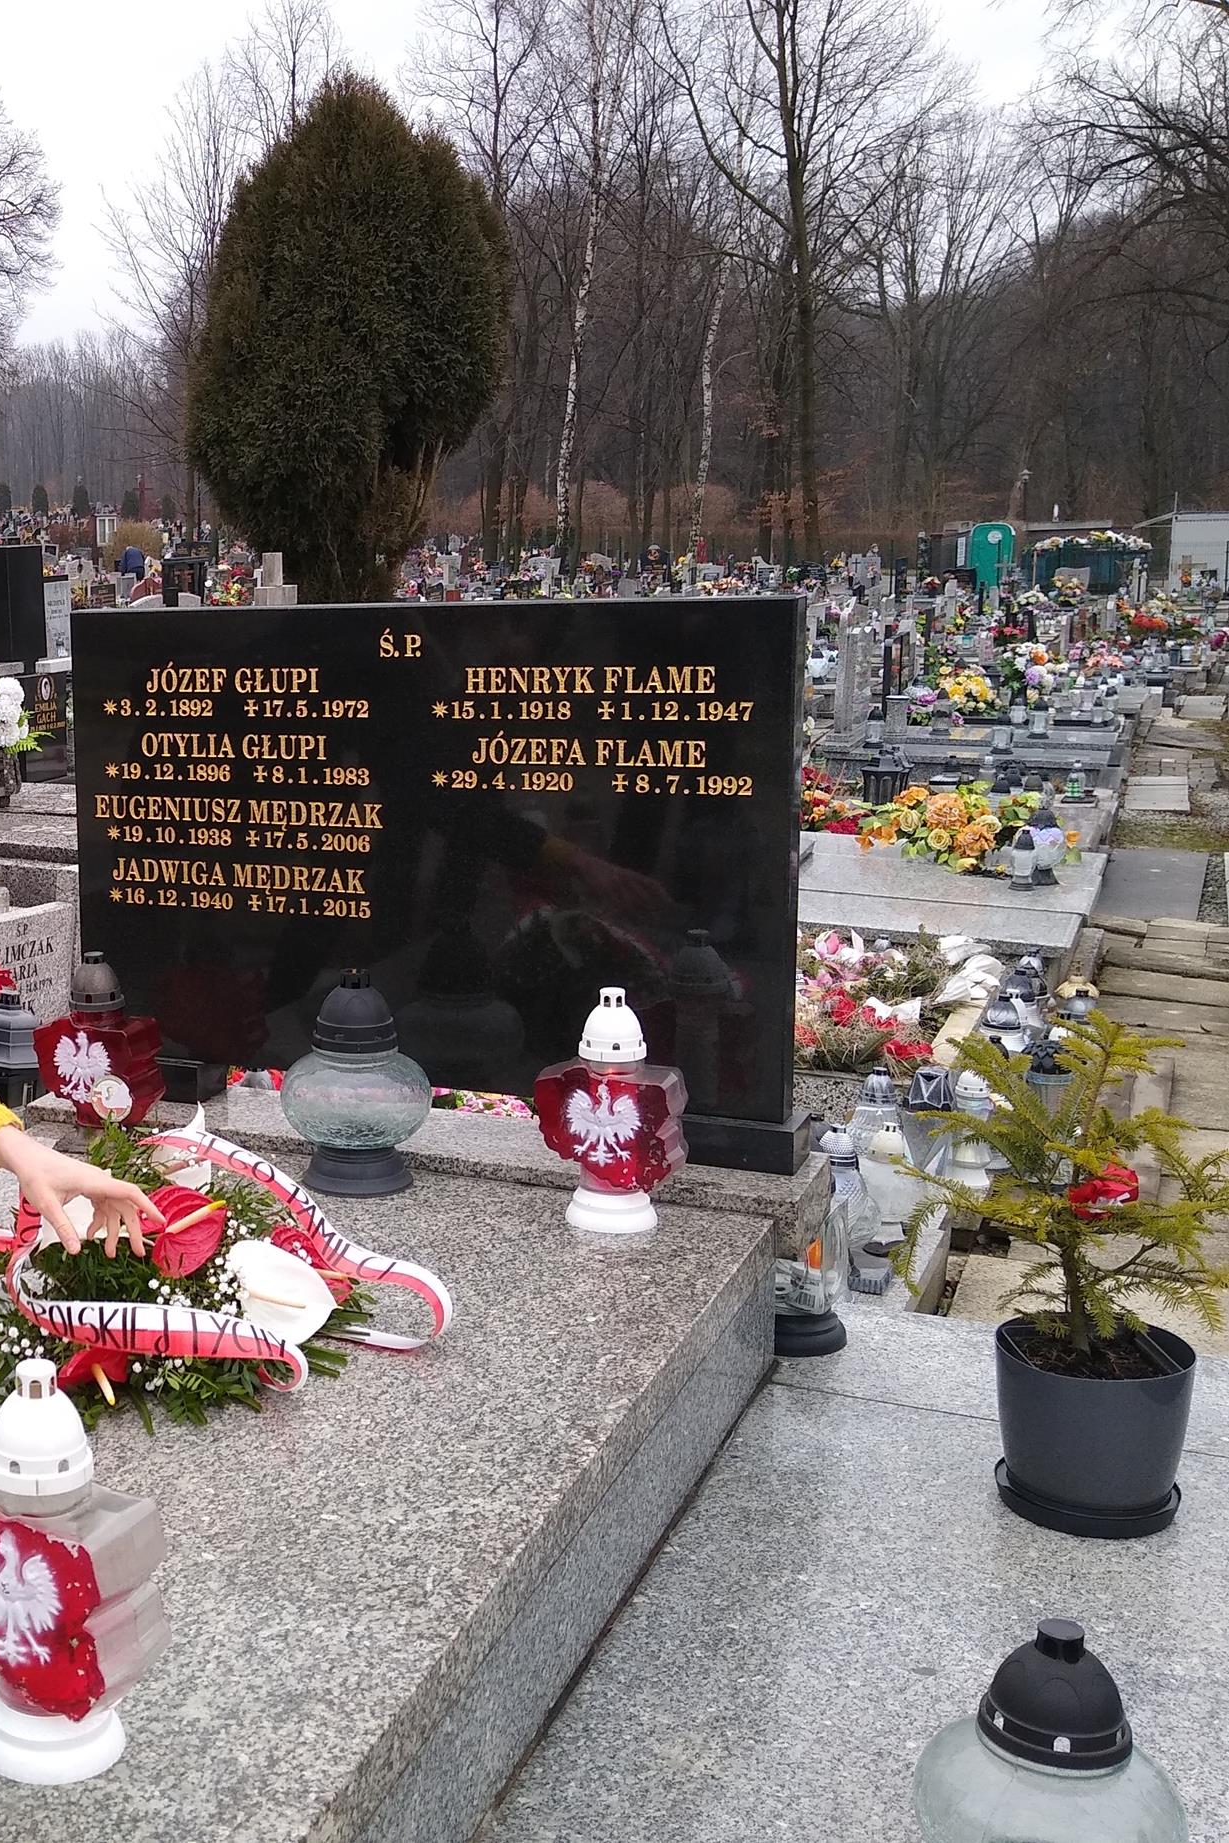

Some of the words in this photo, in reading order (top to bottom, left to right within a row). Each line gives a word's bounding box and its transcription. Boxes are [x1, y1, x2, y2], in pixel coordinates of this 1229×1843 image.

[146, 661, 227, 693] JÓZEF
[234, 667, 319, 694] GŁUPI
[464, 666, 594, 694] HENRYK
[603, 666, 716, 694] FLAME
[36, 712, 56, 723] GACH
[141, 732, 236, 758] OTYLIA
[242, 734, 327, 760] GŁUPI
[472, 730, 586, 766] JÓZEFA
[596, 738, 706, 768] FLAME
[94, 794, 242, 824] EUGENIUSZ
[248, 799, 384, 831] MĘDRZAK
[112, 857, 226, 886] JADWIGA
[232, 862, 366, 895] MĘDRZAK
[12, 963, 38, 982] ARIA
[27, 1300, 169, 1353] POLSKIEJ
